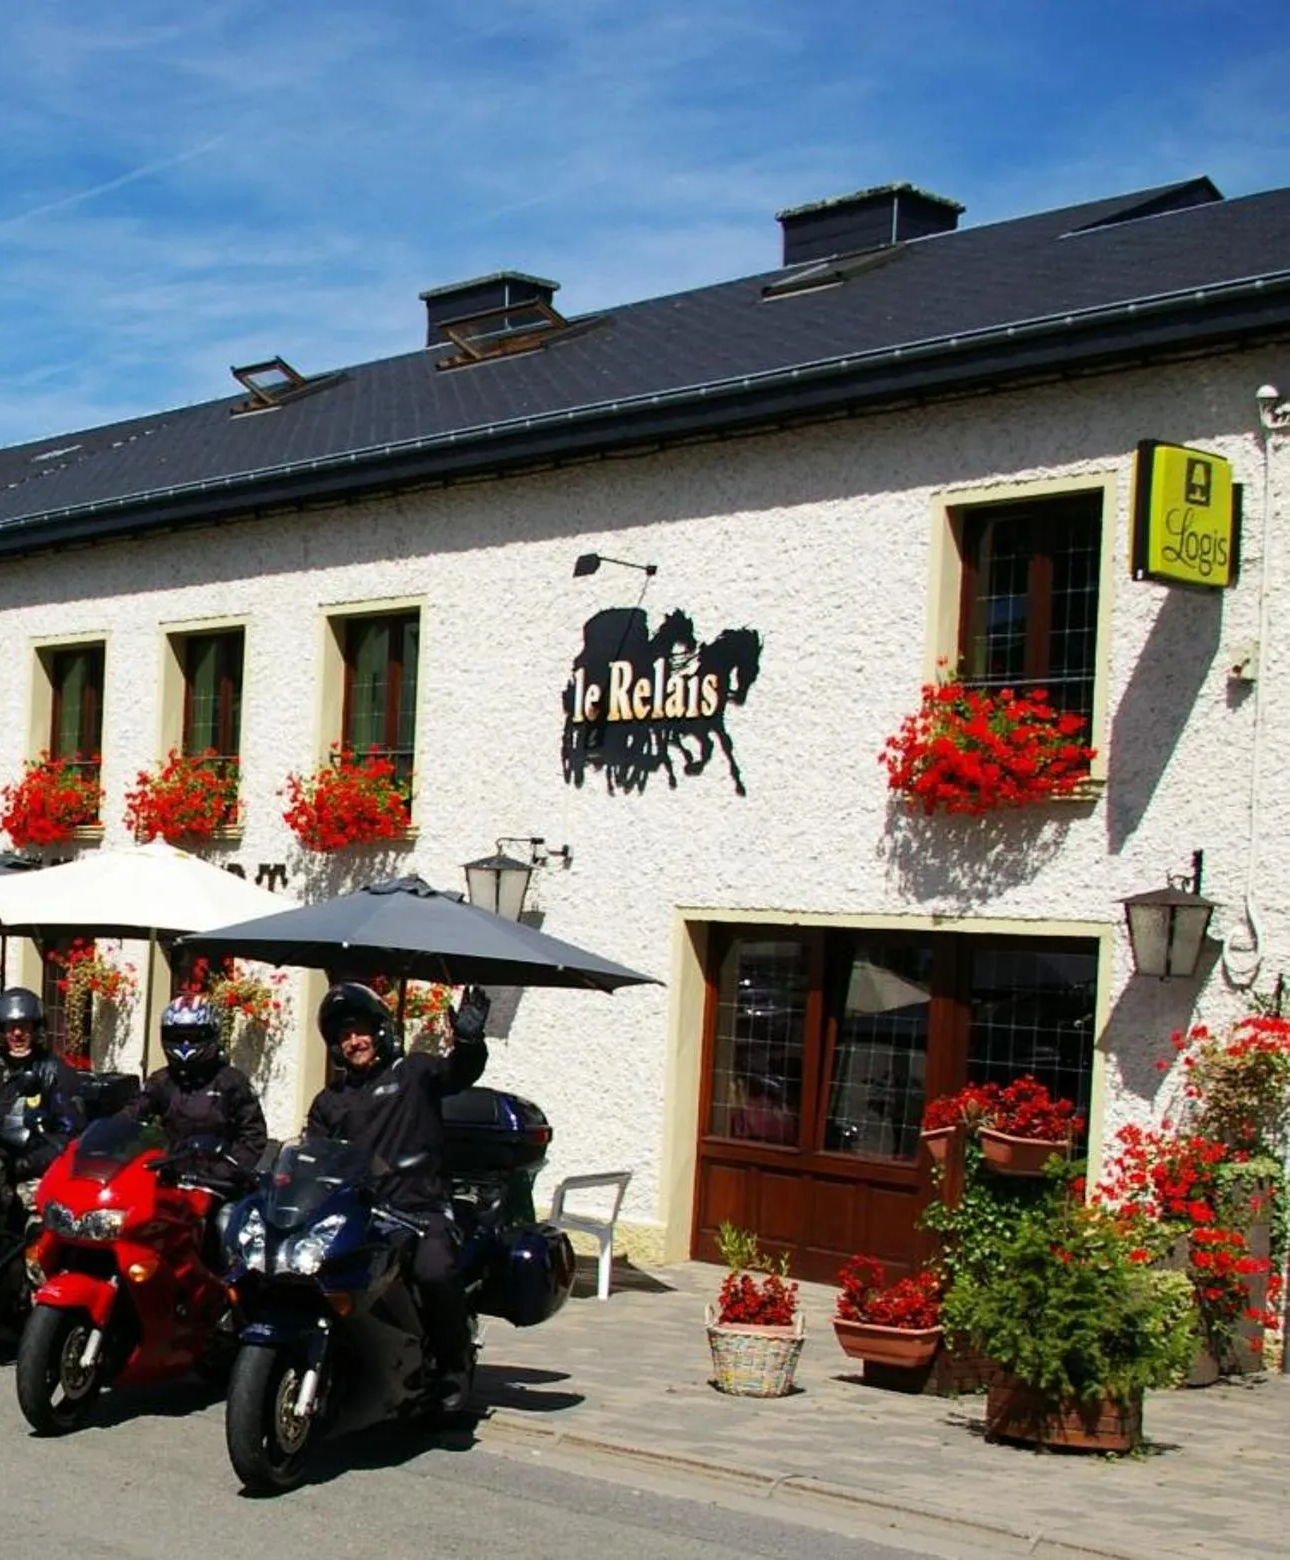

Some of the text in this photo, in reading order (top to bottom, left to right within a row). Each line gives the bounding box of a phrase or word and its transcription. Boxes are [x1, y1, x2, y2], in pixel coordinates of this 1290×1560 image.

[1161, 507, 1227, 576] Logis
[572, 657, 719, 723] le Relais
